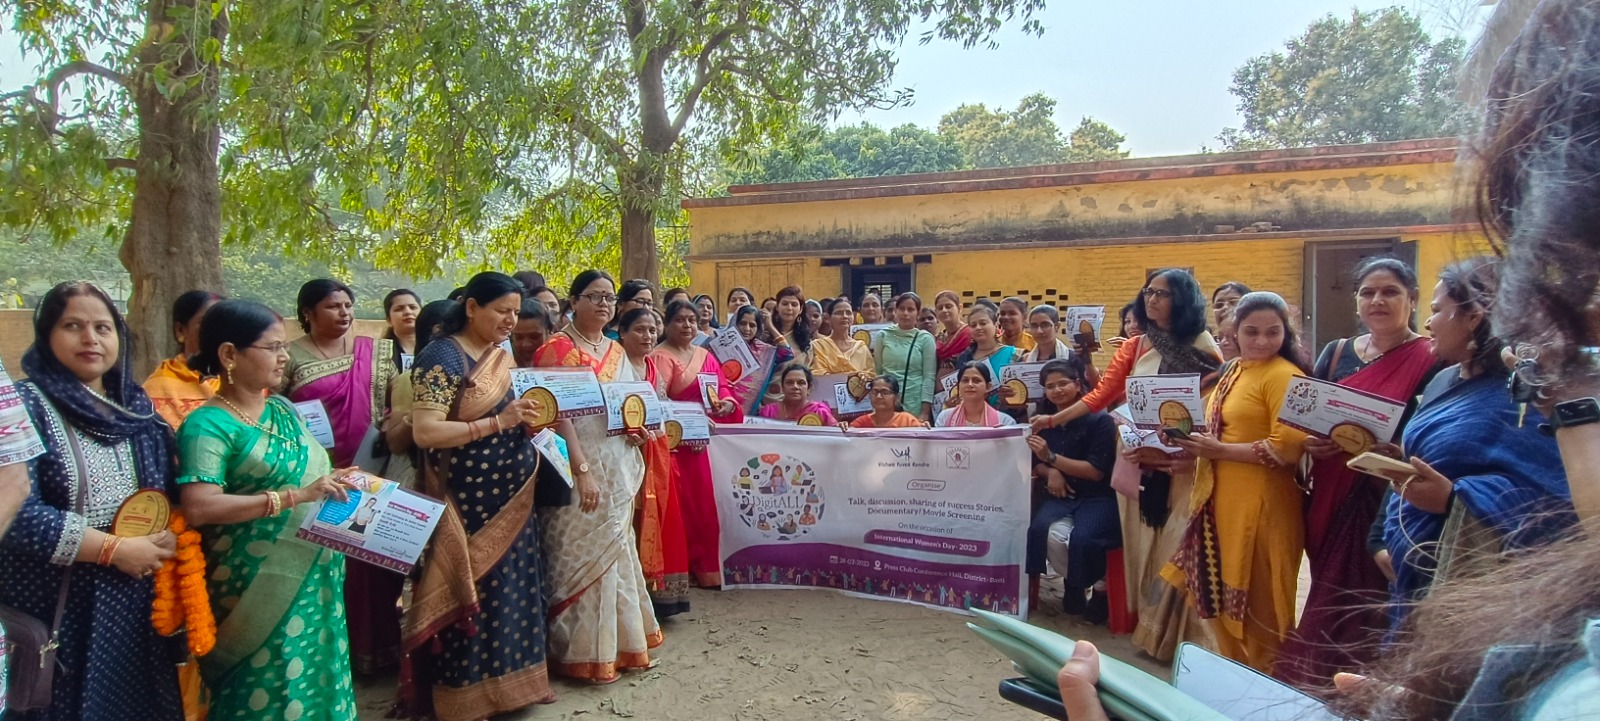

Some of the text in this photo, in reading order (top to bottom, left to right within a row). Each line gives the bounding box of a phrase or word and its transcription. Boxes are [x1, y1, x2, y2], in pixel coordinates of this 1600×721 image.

[911, 481, 941, 490] Organise
[752, 495, 804, 510] DigitALL
[848, 497, 1004, 513] Talk, discussion, sharing of success Stories,
[867, 507, 986, 522] Documentary/ Movie Screening
[909, 522, 919, 530] the
[919, 524, 945, 533] occasion
[946, 527, 953, 535] of
[874, 533, 977, 552] International Women's Day- 2023
[884, 563, 899, 571] Press
[899, 564, 913, 573] Club
[913, 567, 948, 577] Conference
